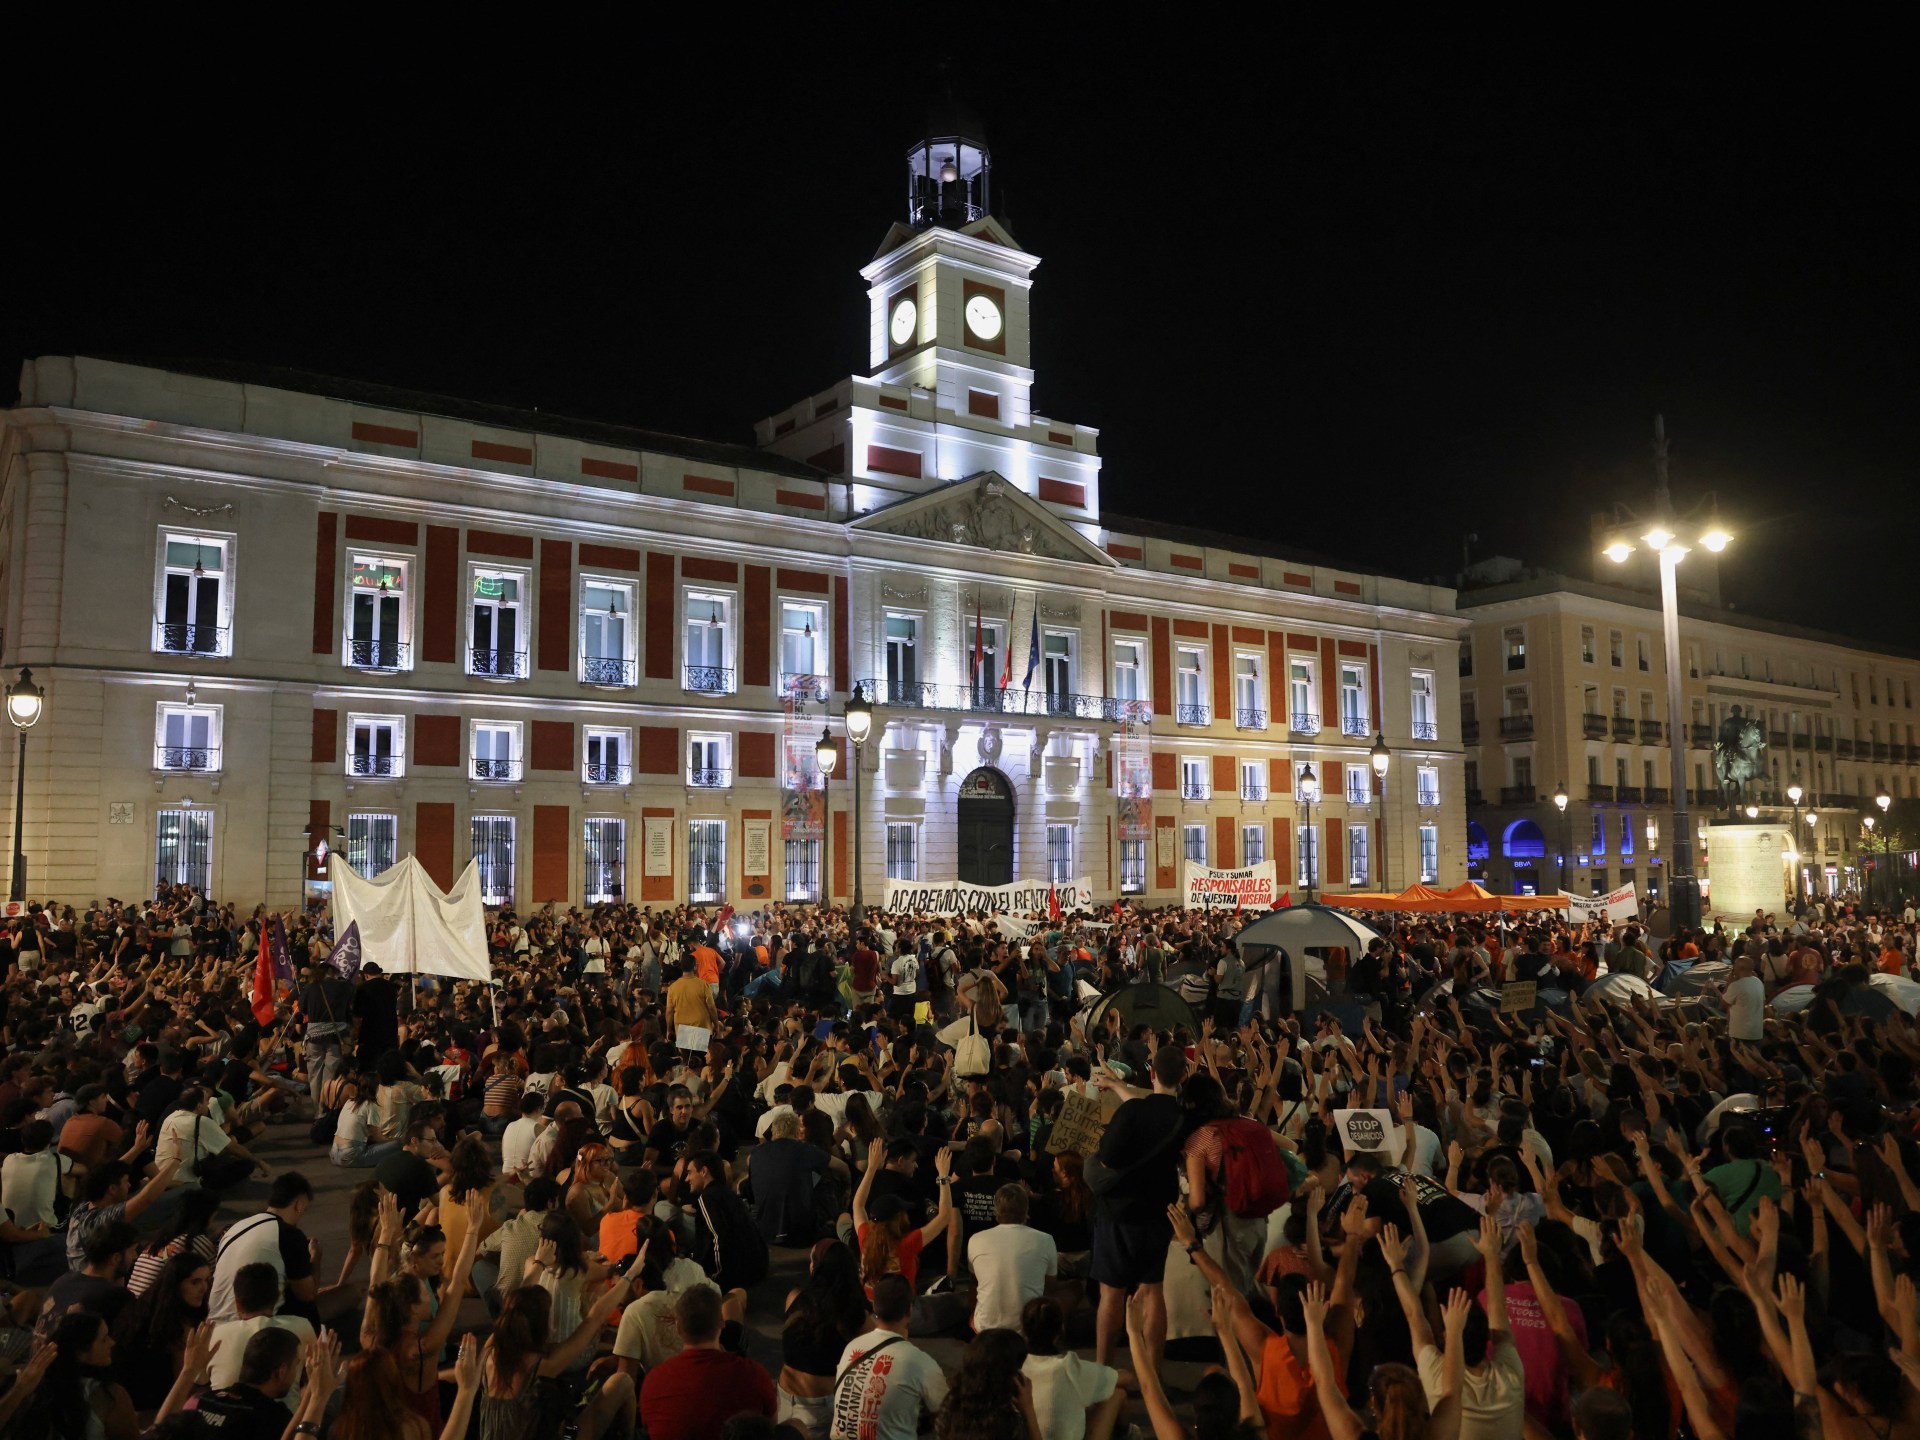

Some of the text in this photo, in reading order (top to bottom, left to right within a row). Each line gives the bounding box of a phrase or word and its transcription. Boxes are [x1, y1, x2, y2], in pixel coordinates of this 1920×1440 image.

[1209, 871, 1224, 879] PSOE
[1231, 871, 1253, 879] SUMAR
[1191, 878, 1271, 893] RESPONSABLES
[889, 889, 967, 914] ACABEMOS
[967, 889, 998, 913] CON
[1013, 887, 1076, 911] RENTIMO
[1191, 893, 1272, 904] DE NUESTRA MISERIA
[1349, 1121, 1378, 1130] STOP
[1350, 1132, 1384, 1140] DESAHUCIOS
[1050, 1134, 1069, 1150] LOS
[1506, 1296, 1539, 1307] SCUELA
